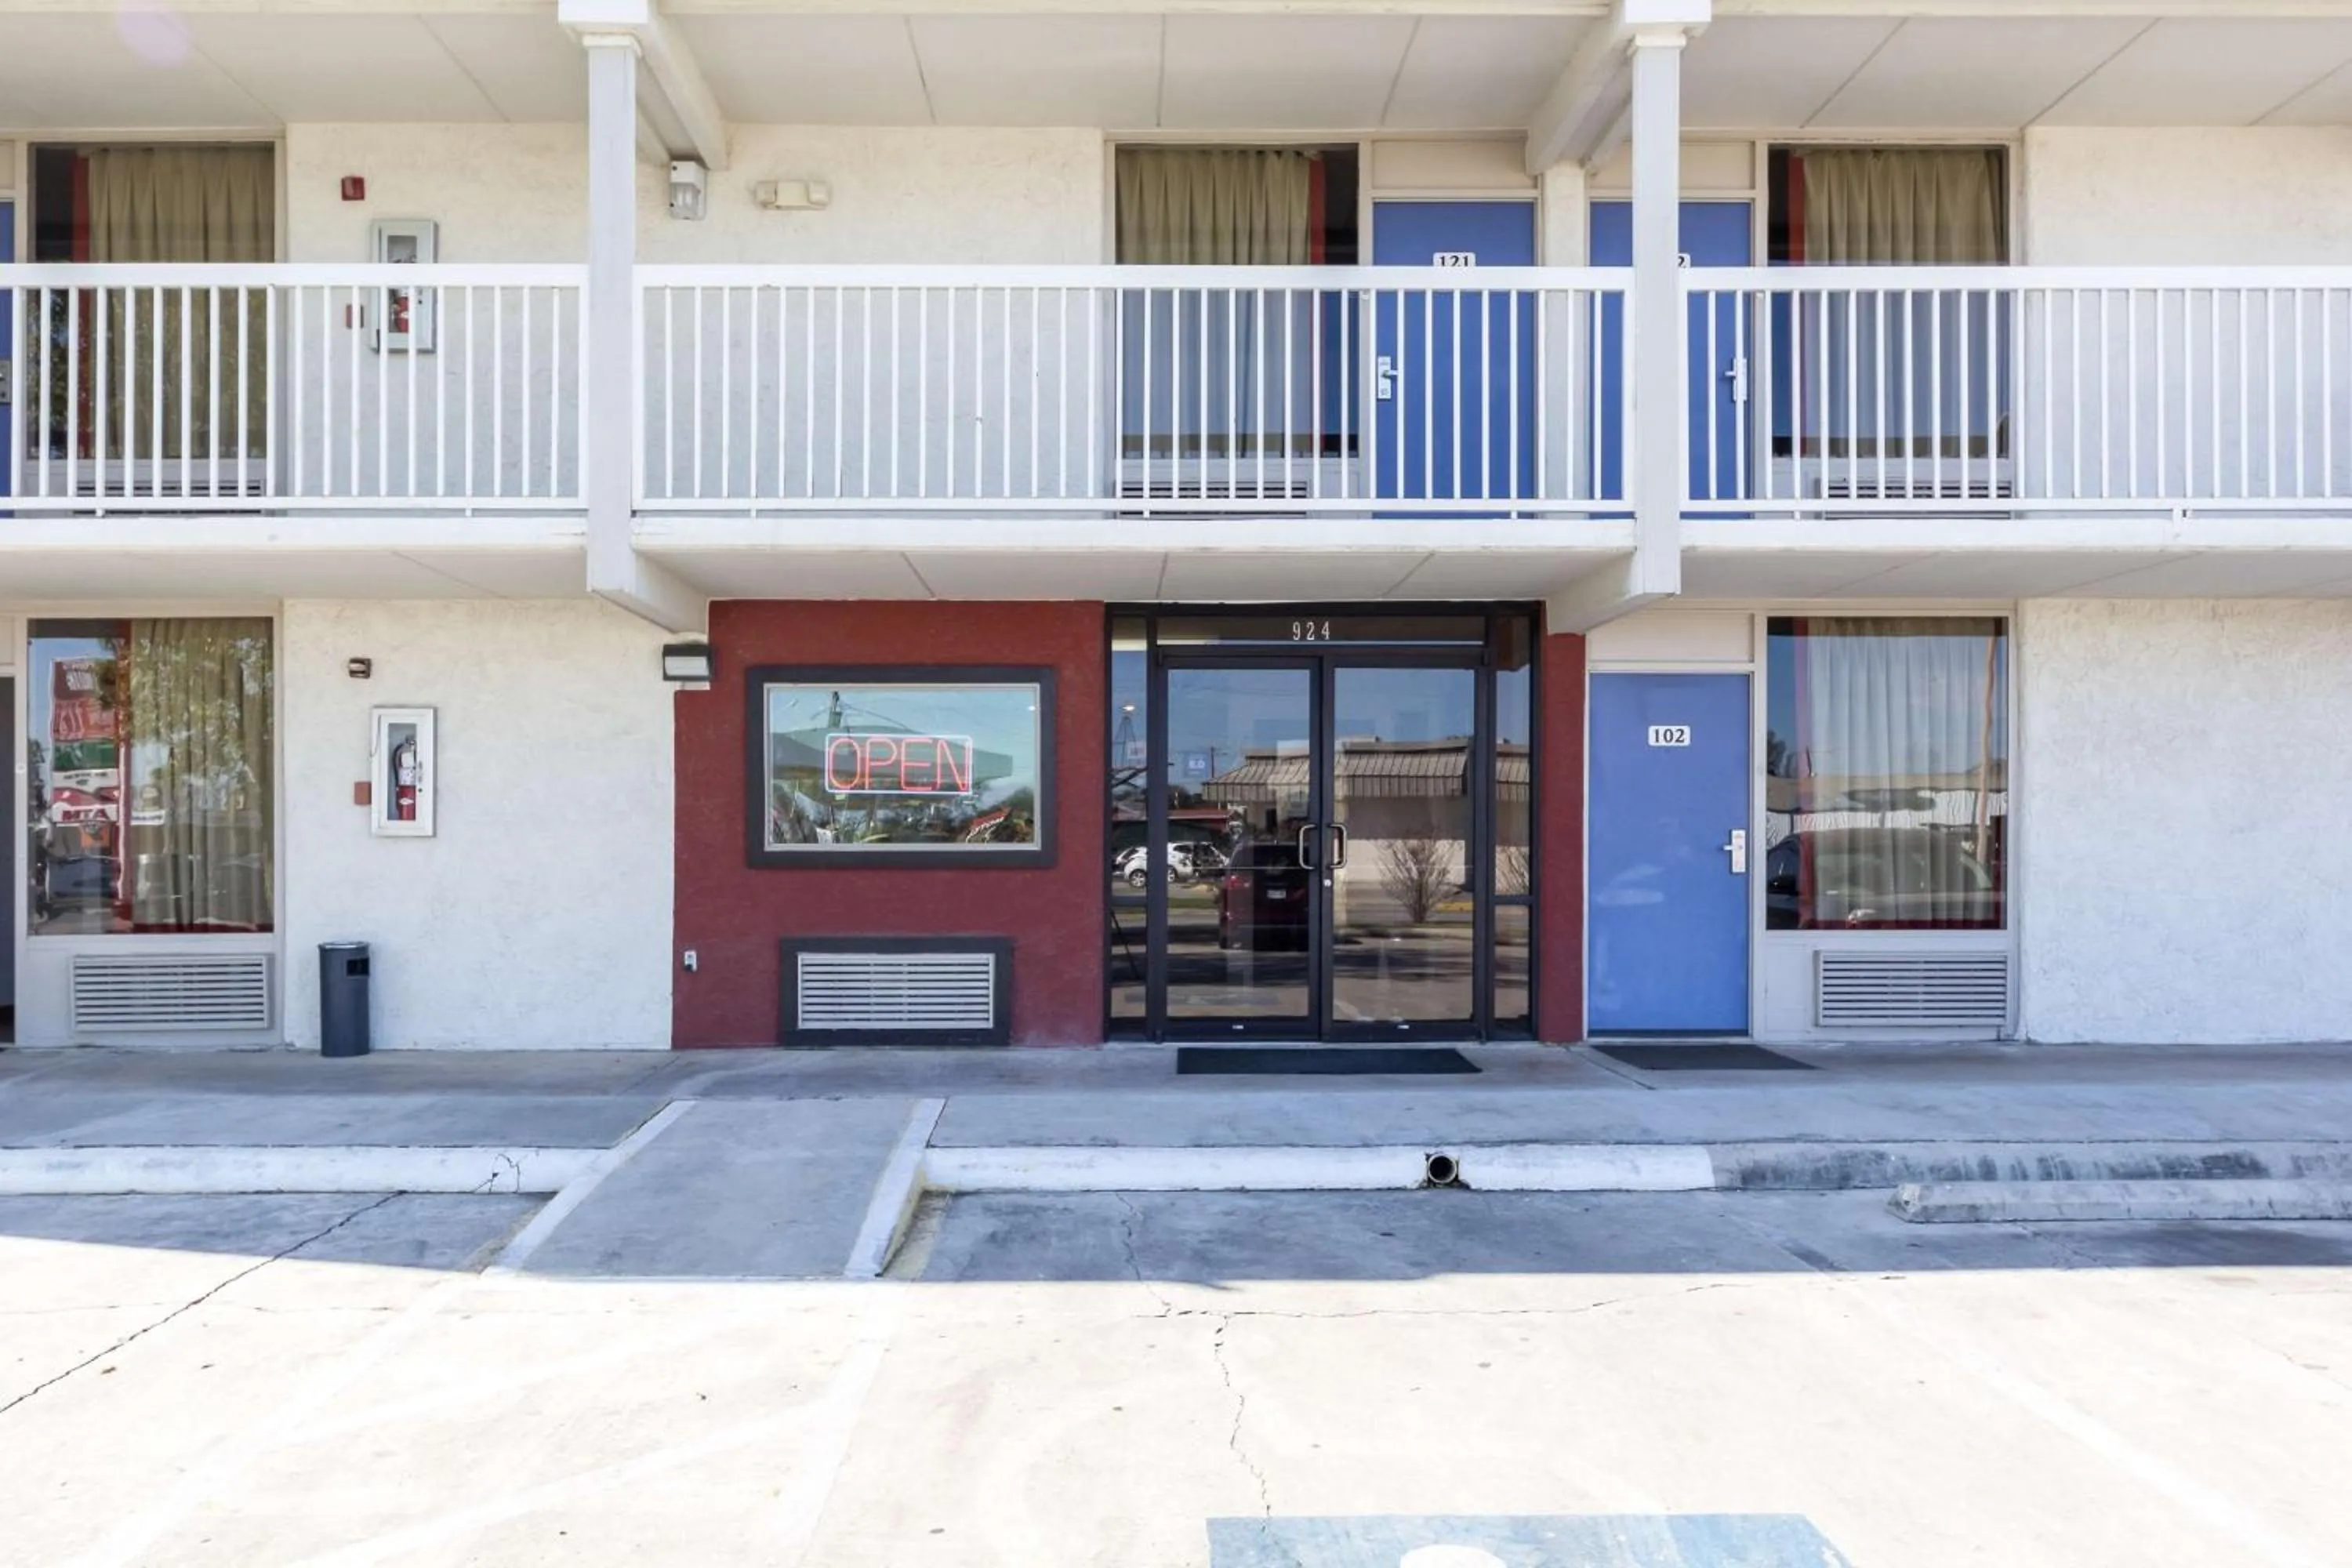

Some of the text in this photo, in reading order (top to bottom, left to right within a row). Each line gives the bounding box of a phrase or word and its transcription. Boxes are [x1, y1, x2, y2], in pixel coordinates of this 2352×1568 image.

[1439, 255, 1468, 267] 121
[1293, 621, 1330, 641] 924
[1654, 728, 1685, 743] 102
[829, 738, 971, 792] OPEN
